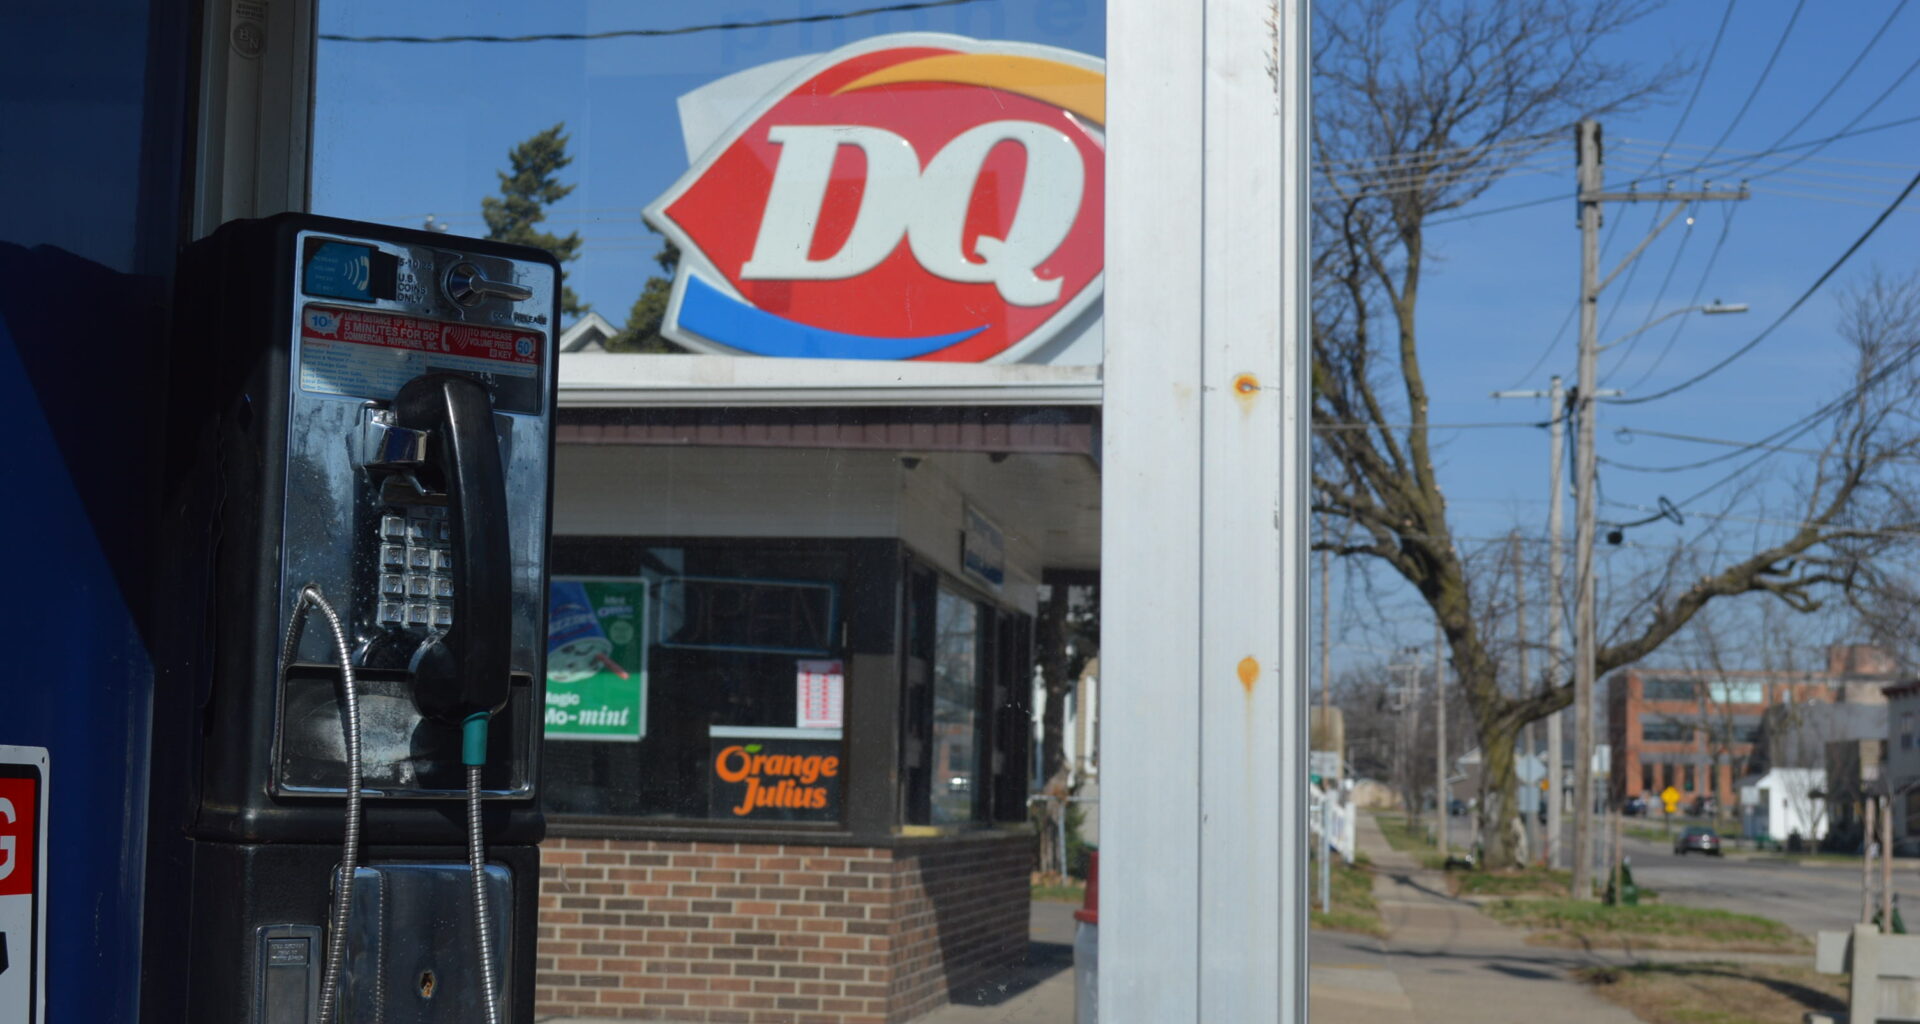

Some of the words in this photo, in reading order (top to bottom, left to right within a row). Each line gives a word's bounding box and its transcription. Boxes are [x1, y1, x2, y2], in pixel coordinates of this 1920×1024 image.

[739, 120, 1086, 308] DQ
[398, 282, 426, 296] COINS
[344, 321, 351, 332] 5
[353, 322, 399, 337] MINUTES
[400, 327, 420, 339] FOR
[344, 331, 385, 345] COMMERCIAL
[715, 744, 839, 783] Orange
[733, 777, 828, 816] Julius
